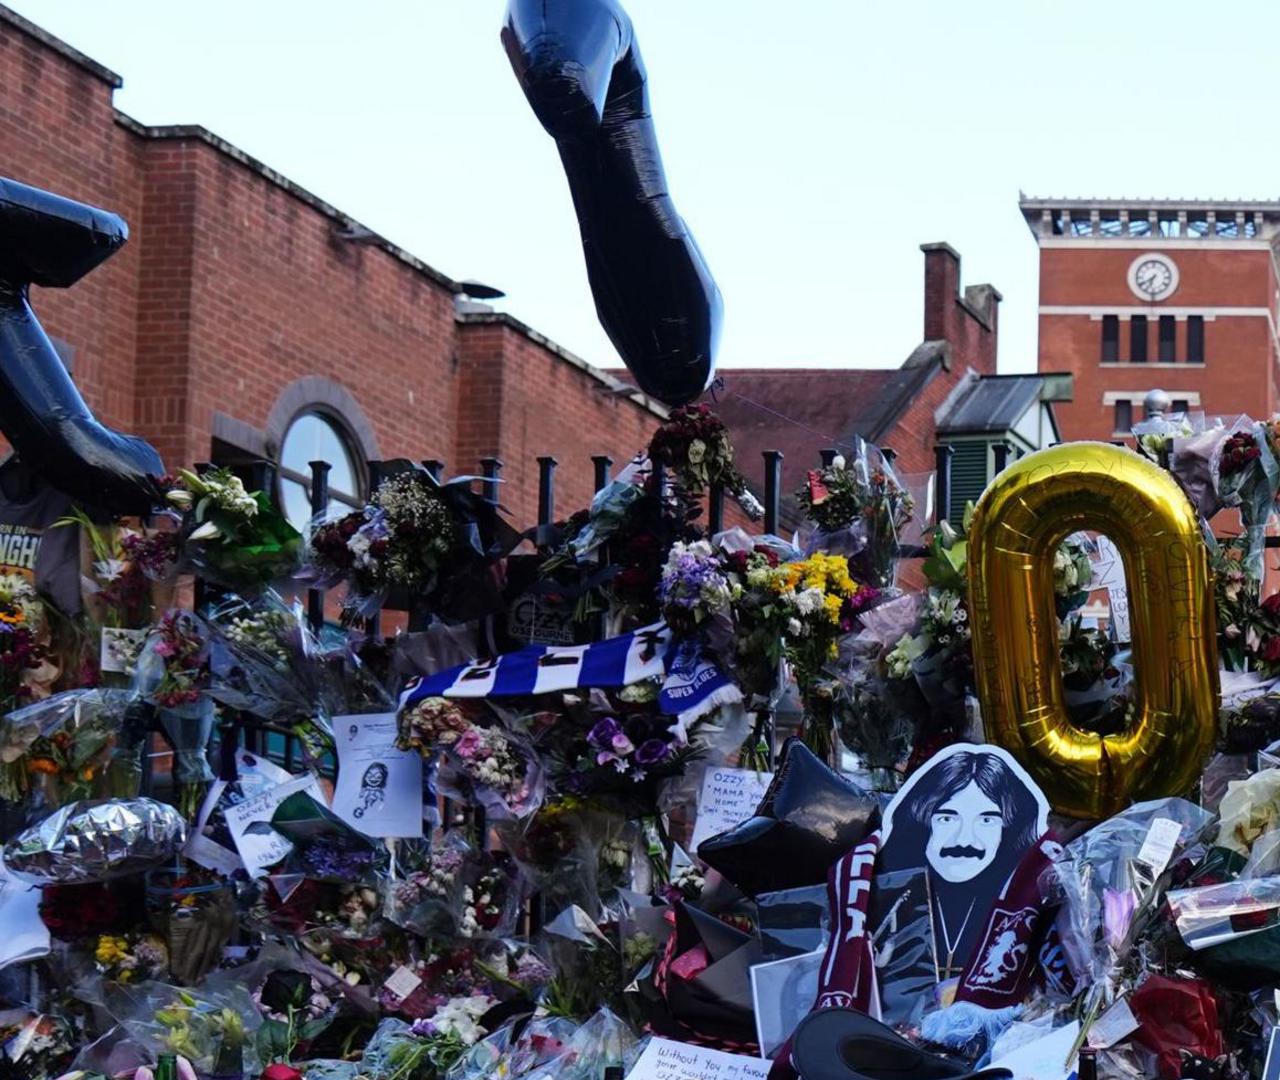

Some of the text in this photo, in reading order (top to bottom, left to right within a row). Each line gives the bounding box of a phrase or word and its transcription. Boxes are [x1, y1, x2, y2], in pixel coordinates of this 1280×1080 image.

[667, 686, 694, 699] SUPER
[657, 1046, 699, 1066] Without
[705, 1058, 721, 1073] You
